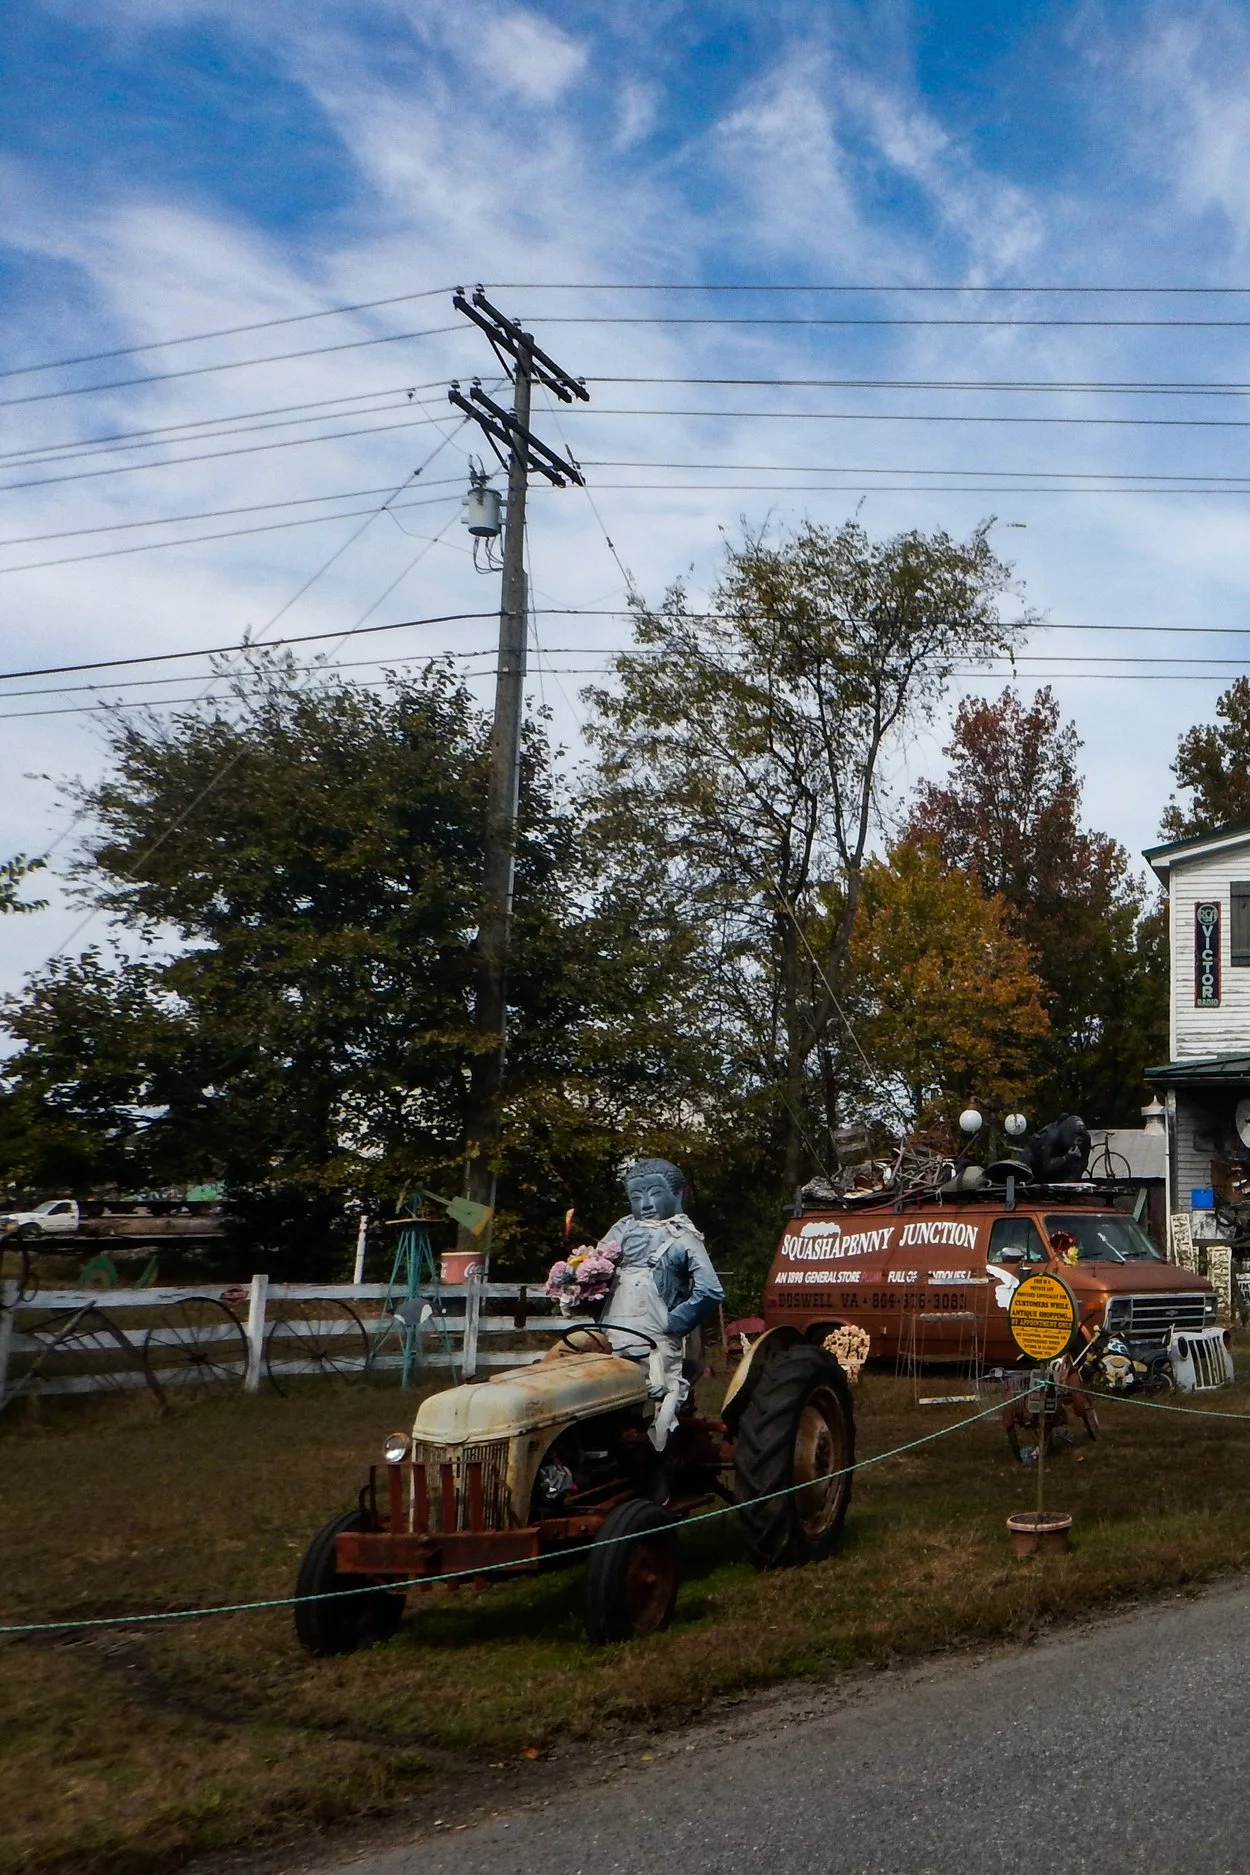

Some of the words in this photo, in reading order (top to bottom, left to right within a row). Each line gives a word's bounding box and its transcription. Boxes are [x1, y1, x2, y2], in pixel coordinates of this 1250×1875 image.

[1201, 925, 1214, 998] VICTOR
[782, 1227, 894, 1261] SQUASHAPENNY
[899, 1221, 978, 1249] JUNCTION
[775, 1272, 787, 1284] AN
[804, 1272, 836, 1284] GENERAL
[837, 1271, 861, 1283] STORE
[887, 1271, 905, 1283] FULL
[778, 1292, 832, 1308] DOSWELL
[841, 1293, 858, 1308] VA
[1015, 1300, 1049, 1308] CUSTOMERS
[1012, 1310, 1037, 1318] ANTIQUE
[1020, 1319, 1057, 1328] APPOINTMENT
[1058, 1321, 1073, 1329] ONLY
